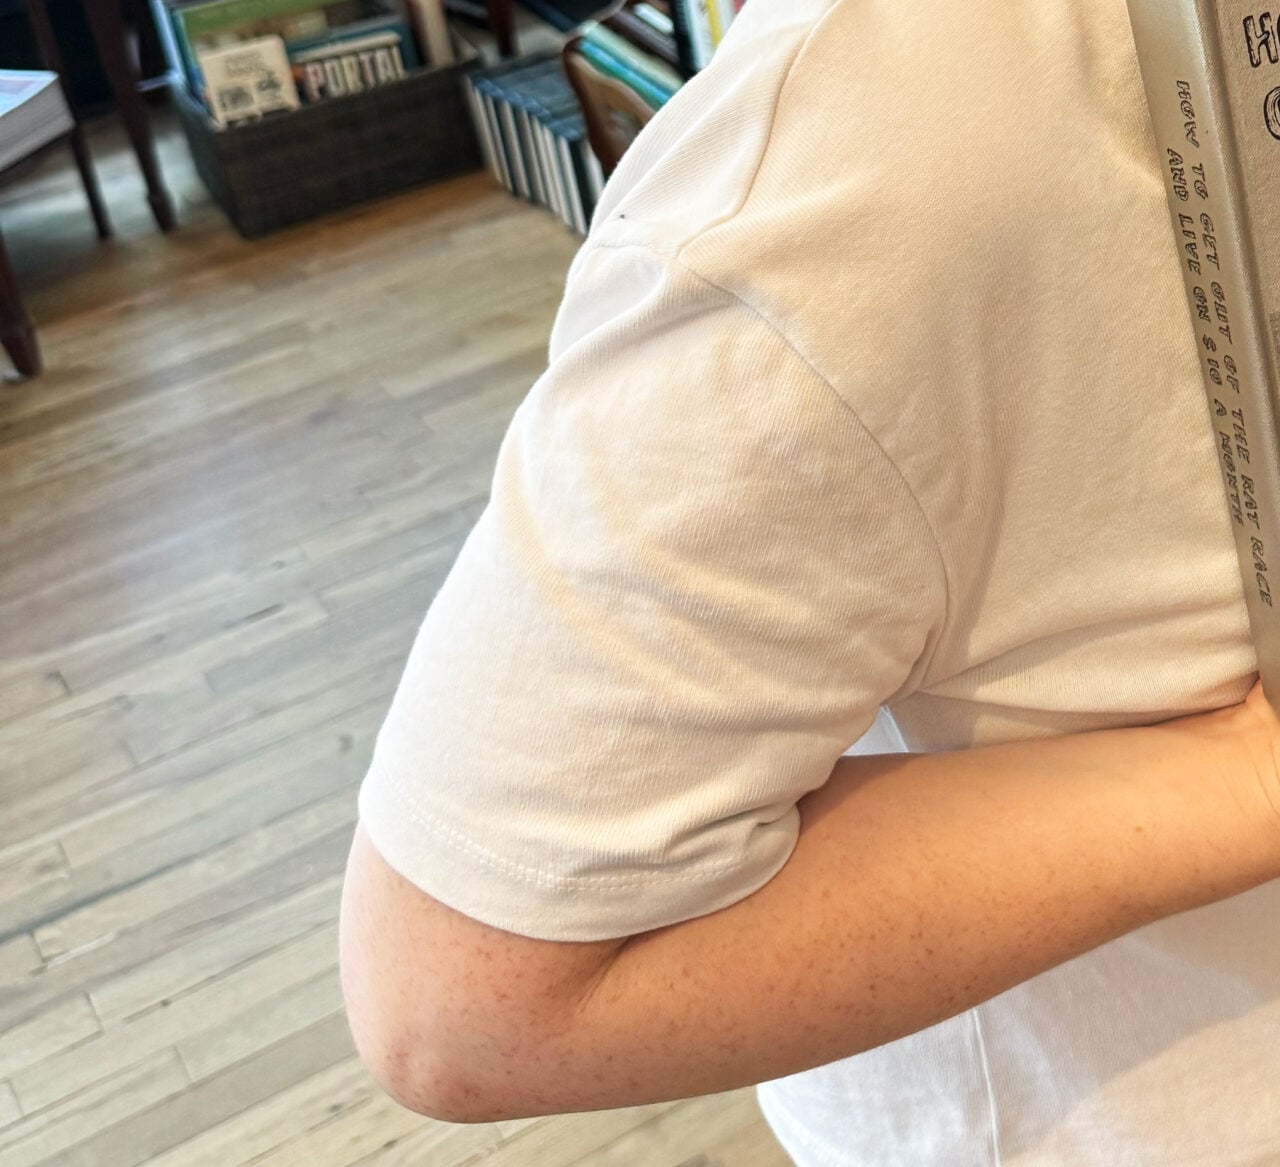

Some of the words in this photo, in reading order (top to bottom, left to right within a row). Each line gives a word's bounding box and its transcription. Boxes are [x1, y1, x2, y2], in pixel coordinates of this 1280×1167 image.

[1176, 79, 1200, 149] HOW
[1166, 147, 1190, 202] AND
[1191, 163, 1209, 200] TO
[1178, 212, 1203, 277] LIVE
[1199, 212, 1221, 271] GET
[1192, 285, 1212, 324] ON
[1210, 281, 1233, 345] OUT
[1202, 332, 1224, 387] $10
[1223, 354, 1240, 395] OF
[1213, 397, 1228, 417] A
[1231, 407, 1251, 466] THE
[1218, 430, 1245, 529] MONTH
[1240, 472, 1261, 531] RAT
[1250, 535, 1274, 609] RACE
